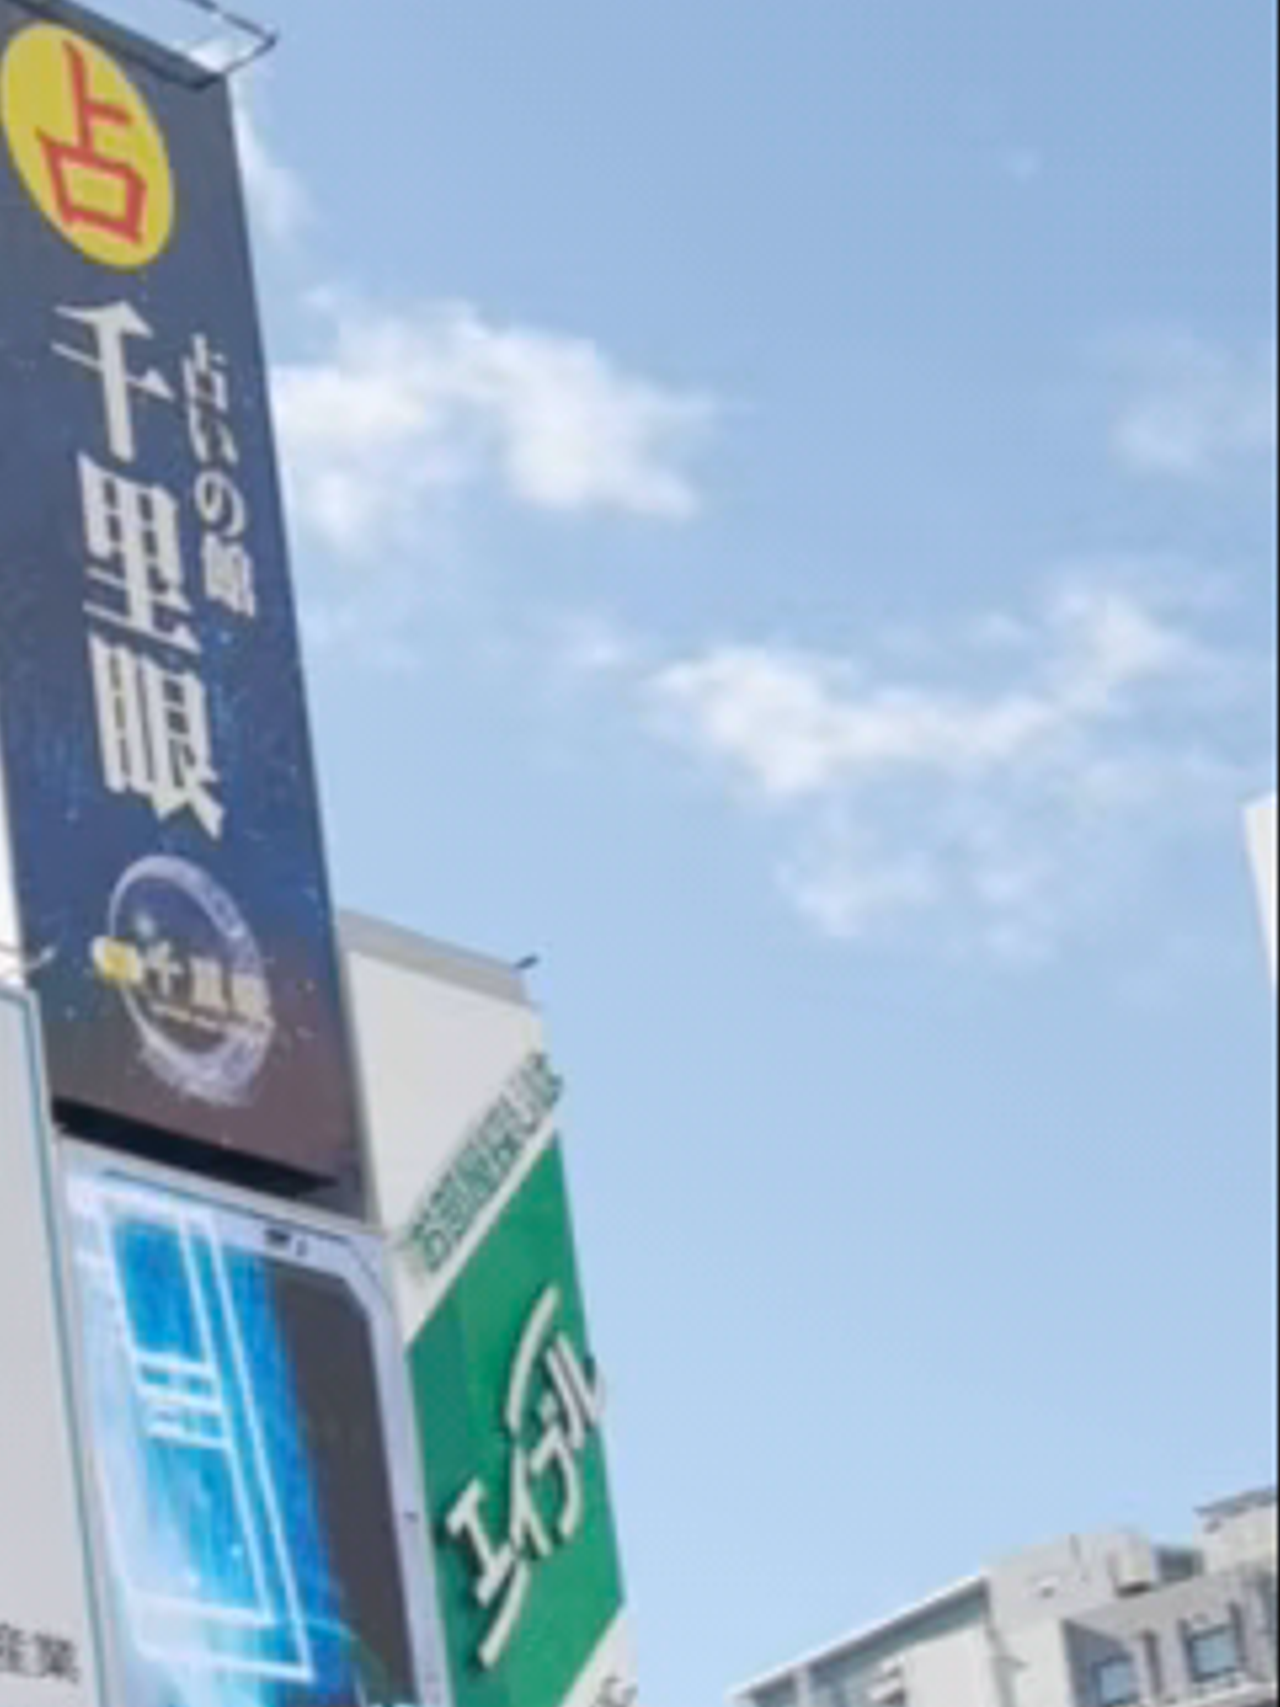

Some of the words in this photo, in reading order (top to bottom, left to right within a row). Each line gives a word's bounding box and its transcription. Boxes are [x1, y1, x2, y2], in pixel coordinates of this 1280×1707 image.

[36, 38, 148, 246] 占
[52, 297, 225, 840] 千里眼
